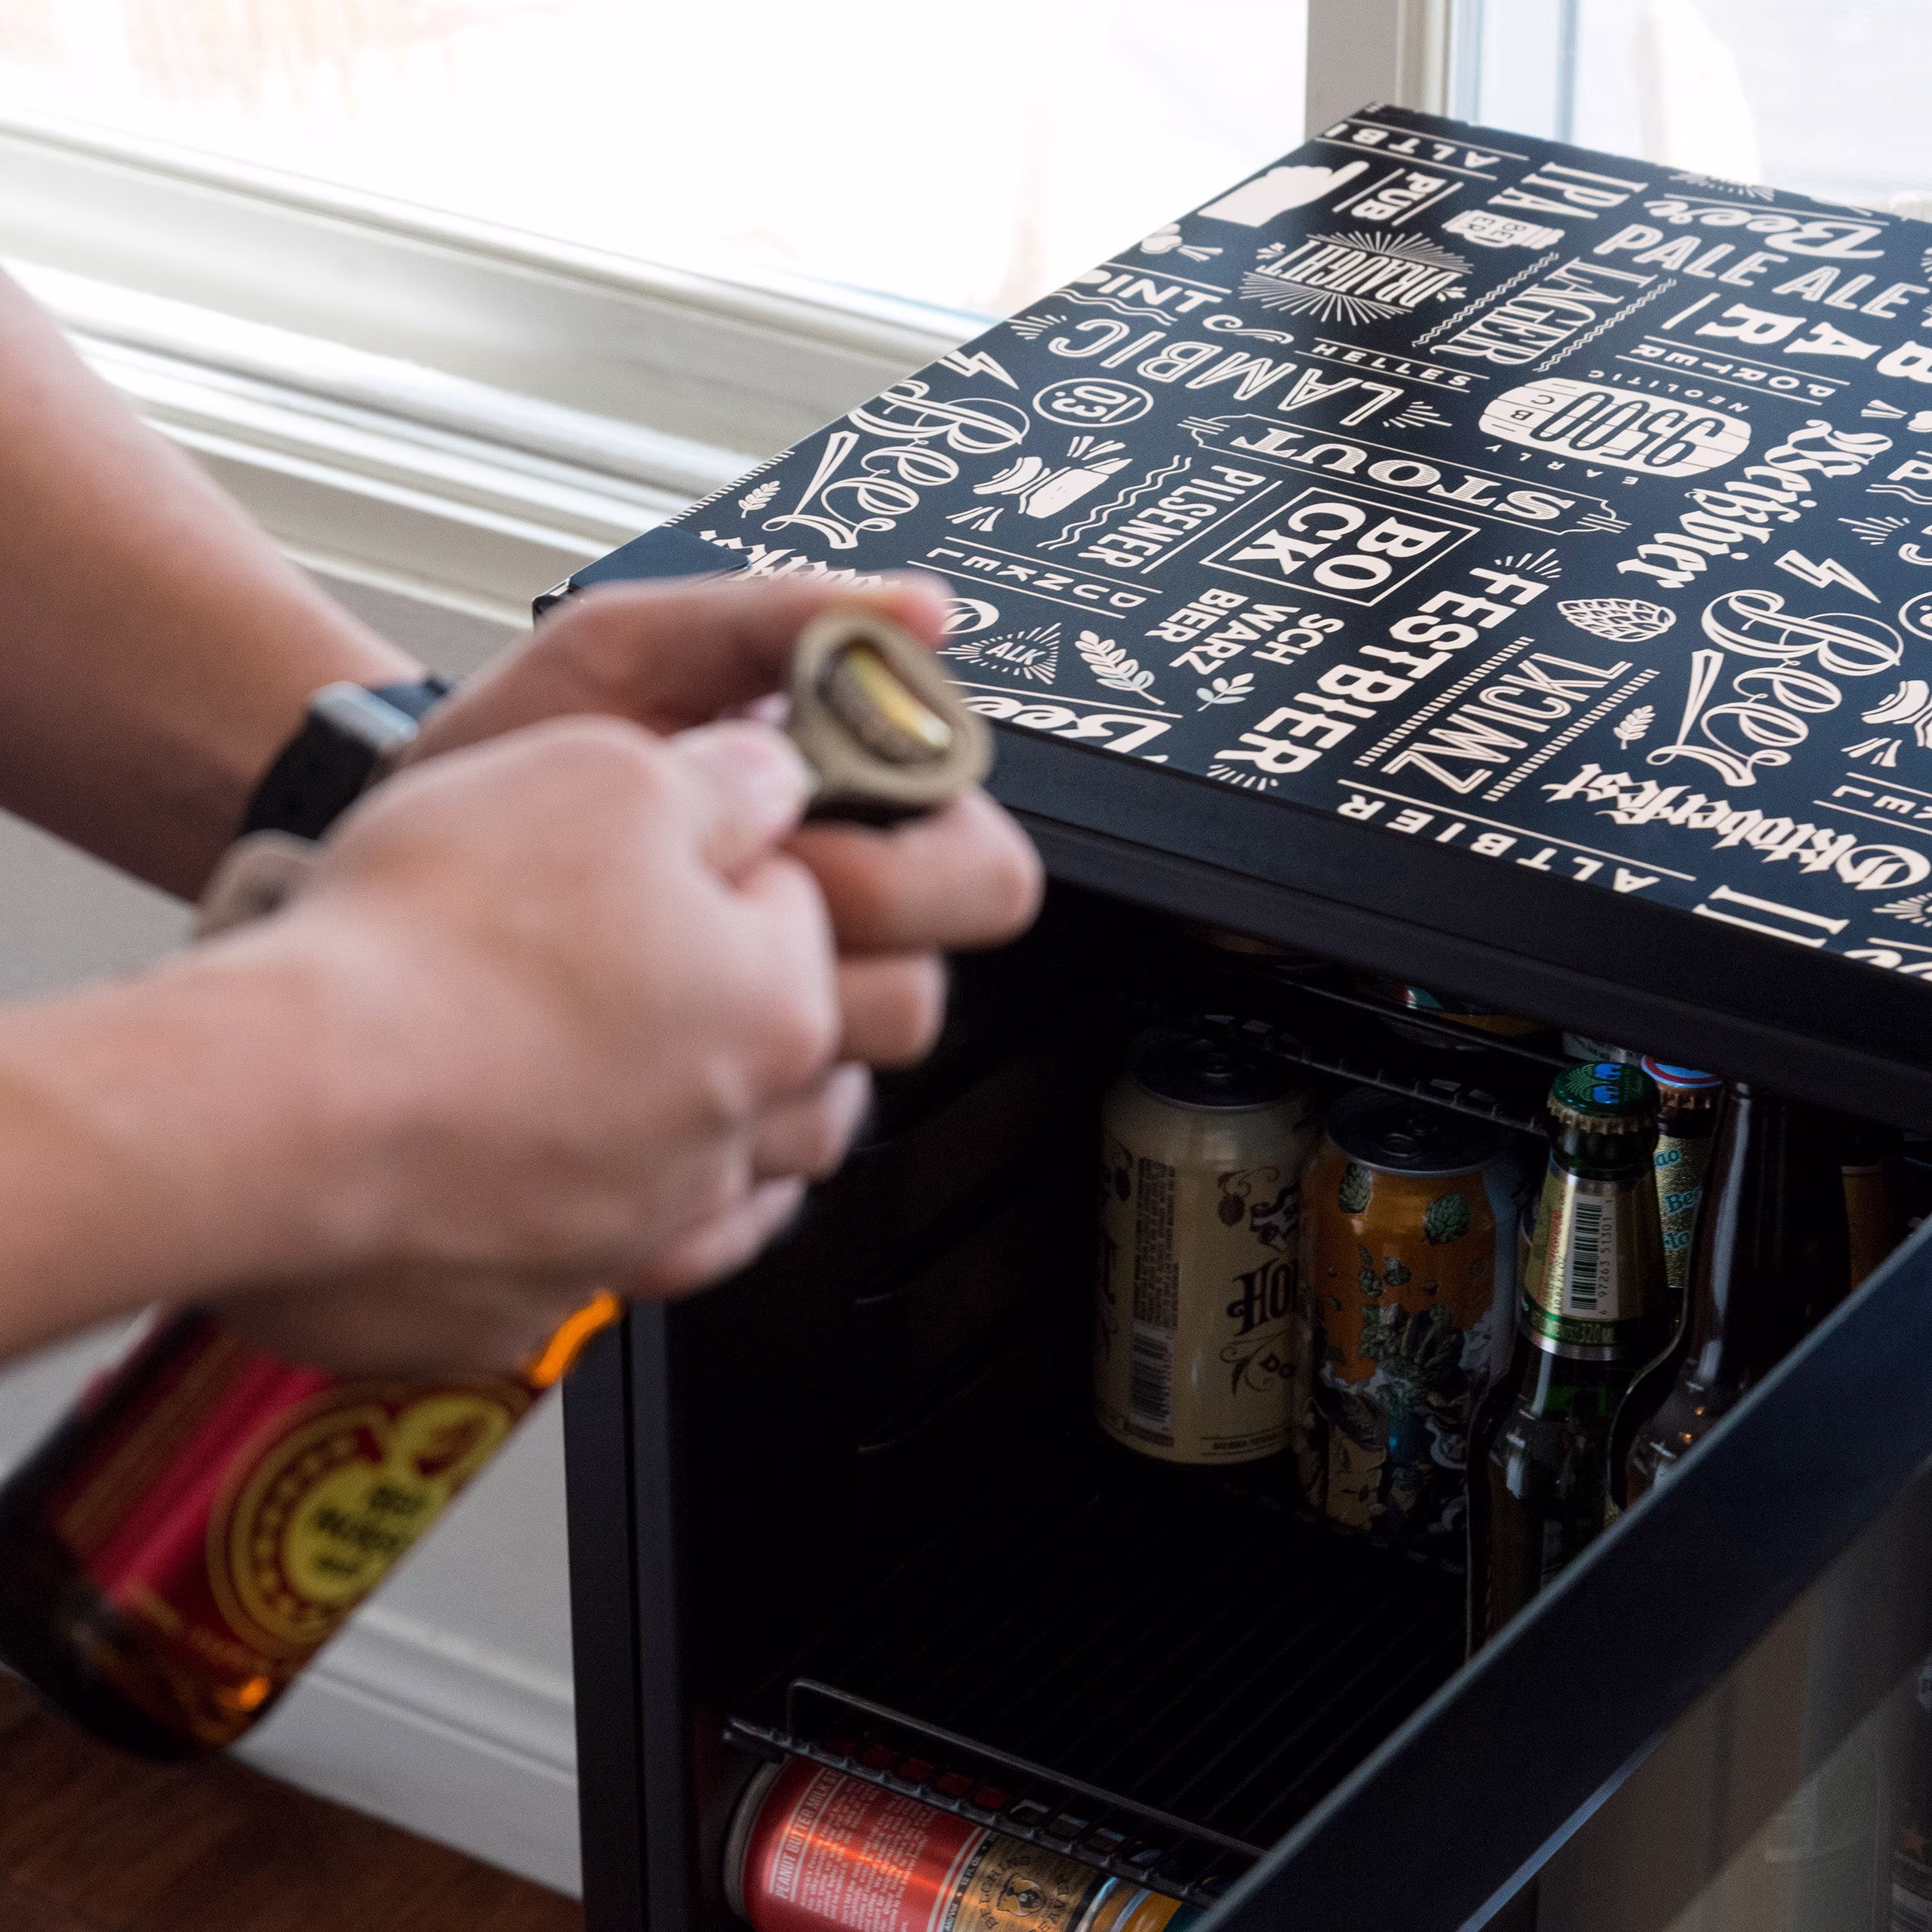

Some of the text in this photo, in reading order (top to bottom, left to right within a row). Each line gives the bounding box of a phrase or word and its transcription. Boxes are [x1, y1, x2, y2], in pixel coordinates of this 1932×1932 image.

[1351, 172, 1447, 222] PUB
[1488, 162, 1649, 219] IPA
[1644, 199, 1885, 259] Beer
[1256, 241, 1458, 307] DRAUGHT
[1593, 224, 1930, 318] PALE ALE
[1430, 257, 1658, 365] LAGER
[1047, 318, 1405, 426] LAMBIC
[1311, 343, 1471, 386] HELLES
[1589, 370, 1749, 412] NEOLITIC
[1630, 343, 1835, 398] PORTER
[1529, 390, 1726, 467] 9500
[1229, 426, 1574, 521] STOUT
[1485, 445, 1639, 485] EARLY
[1078, 466, 1266, 567] PILSENER
[927, 547, 1146, 608] DUNKEL
[1144, 588, 1249, 643] BIER
[1168, 604, 1300, 675] WARZ
[1251, 614, 1344, 664] SCH
[985, 641, 1046, 665] ALK
[1214, 568, 1549, 774] FESTBIER
[1380, 654, 1632, 794] ZWICKL
[1337, 794, 1660, 893] ALTBIER
[1542, 763, 1931, 891] Oktoberfest
[1600, 1216, 1612, 1254] 51301
[1598, 1256, 1609, 1298] 97263
[775, 1858, 794, 1900] PEANUT
[788, 1811, 813, 1859] BUTTER
